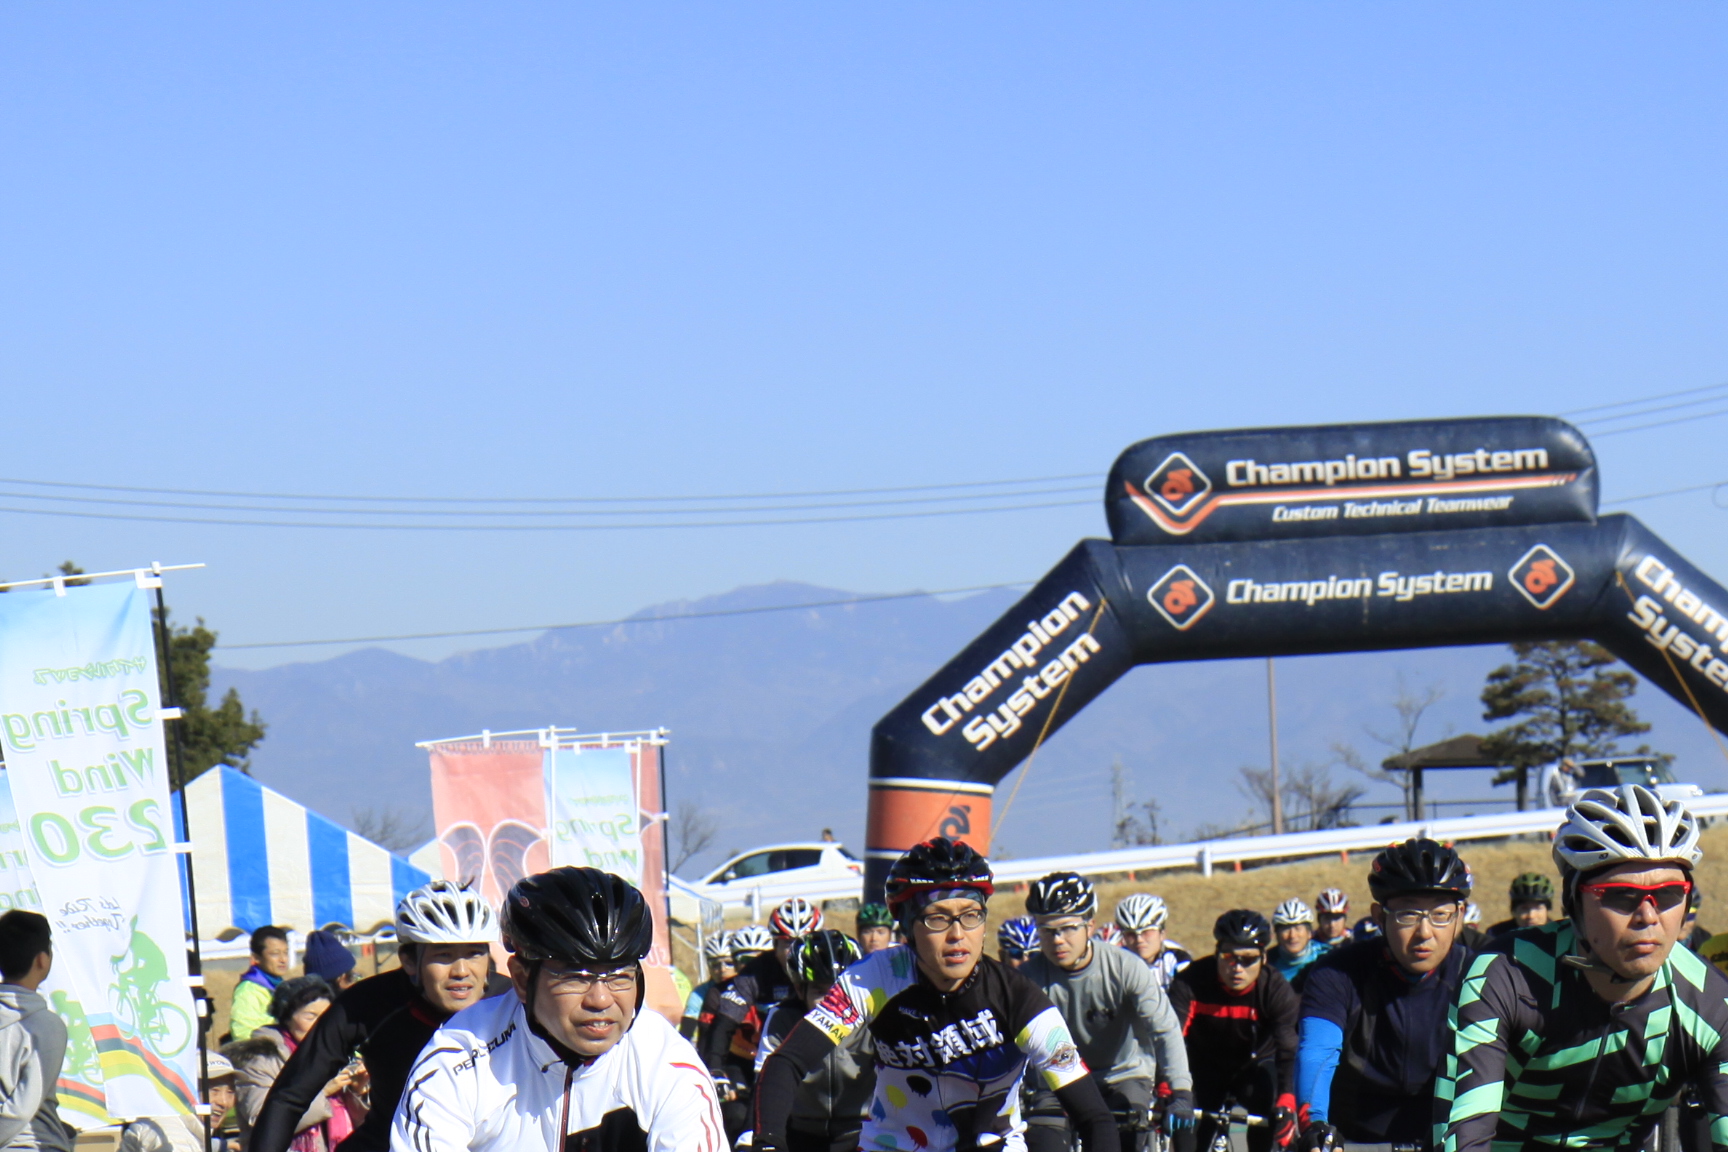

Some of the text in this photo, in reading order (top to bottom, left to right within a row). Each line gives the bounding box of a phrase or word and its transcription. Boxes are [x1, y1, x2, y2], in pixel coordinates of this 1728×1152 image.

[1225, 448, 1549, 486] Champion System
[1272, 495, 1515, 522] Custom Technical Teamwear
[1226, 571, 1494, 606] Champion System
[921, 591, 1091, 736] Champion
[961, 632, 1102, 752] System
[874, 1008, 1005, 1068] 絶対領域
